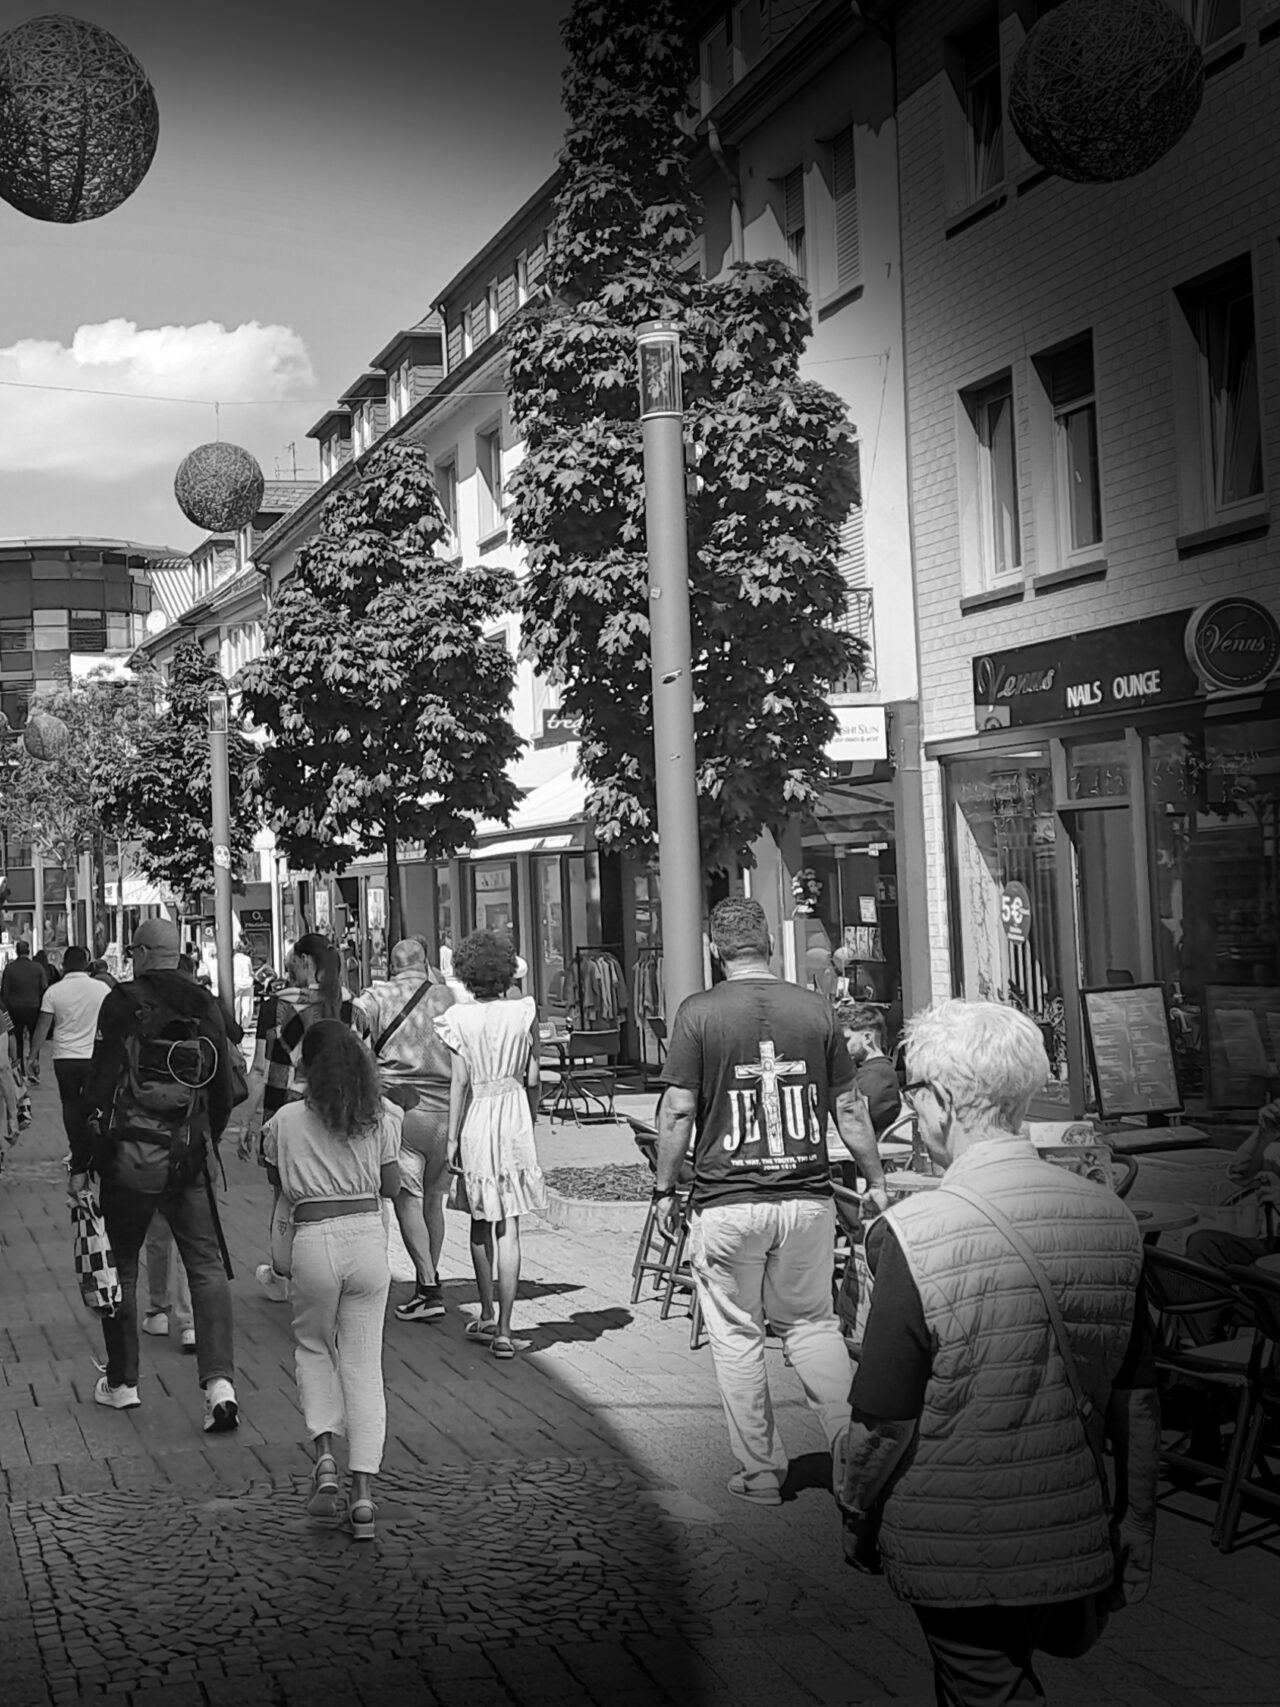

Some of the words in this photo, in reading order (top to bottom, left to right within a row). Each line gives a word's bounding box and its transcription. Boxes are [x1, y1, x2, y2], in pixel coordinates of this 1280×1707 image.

[1197, 620, 1267, 656] Venus
[1066, 681, 1102, 708] NAILS
[1113, 670, 1161, 700] OUNGE
[723, 1083, 821, 1151] JEUS
